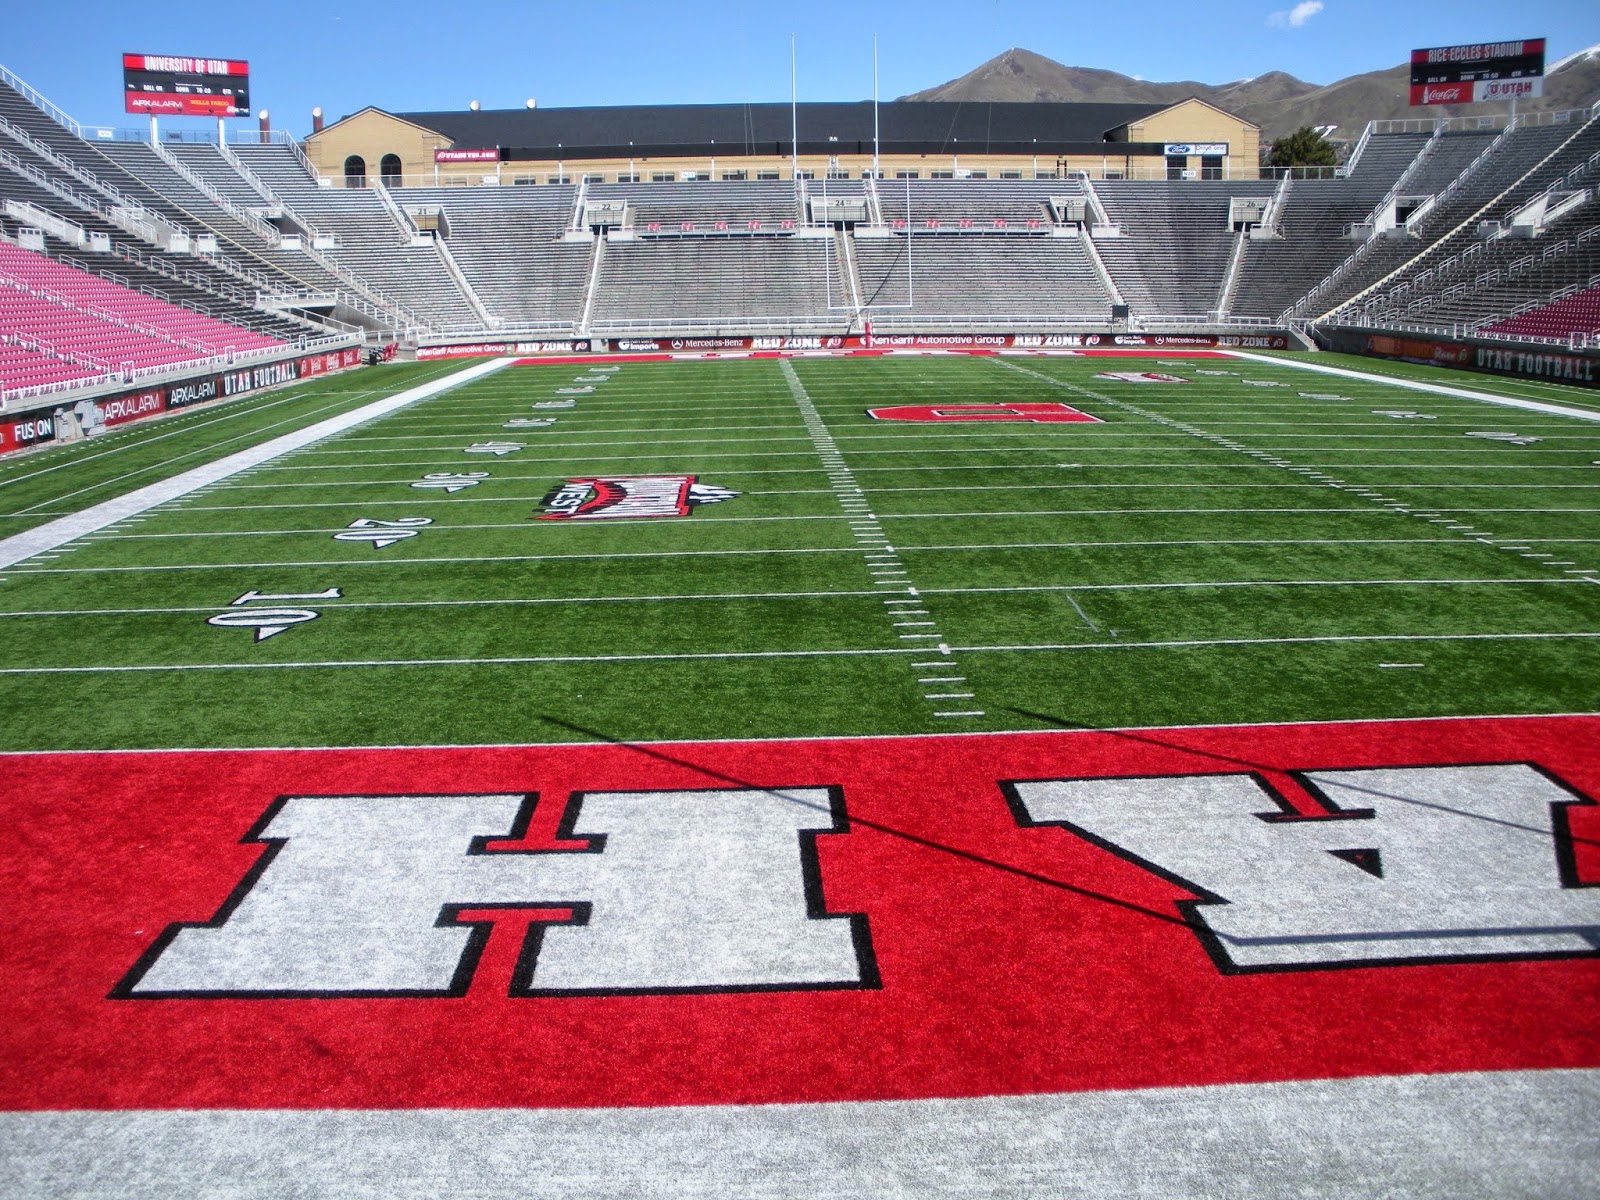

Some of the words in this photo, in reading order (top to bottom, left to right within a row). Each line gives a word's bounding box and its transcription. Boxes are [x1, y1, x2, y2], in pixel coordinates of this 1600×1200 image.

[1428, 45, 1481, 62] RICE-ECCLES
[1484, 42, 1523, 58] STADIUM
[144, 56, 192, 72] UNIVERSITY
[196, 60, 204, 73] OF
[208, 60, 228, 75] UTAH
[1502, 82, 1532, 94] UTAH
[447, 346, 482, 354] Automotive
[484, 345, 505, 353] Group
[685, 339, 743, 348] Mercedes-Benz
[917, 336, 972, 344] Automotive
[975, 335, 1005, 346] Group
[1219, 336, 1240, 346] RED
[1242, 337, 1270, 347] ZONE
[1477, 348, 1512, 370] UTAH
[1518, 352, 1593, 381] FOOTBALL
[224, 372, 251, 396] UTAH
[254, 360, 296, 389] FOOTBALL
[544, 484, 592, 514] WEST
[332, 517, 435, 541] 20
[206, 588, 344, 626] 10
